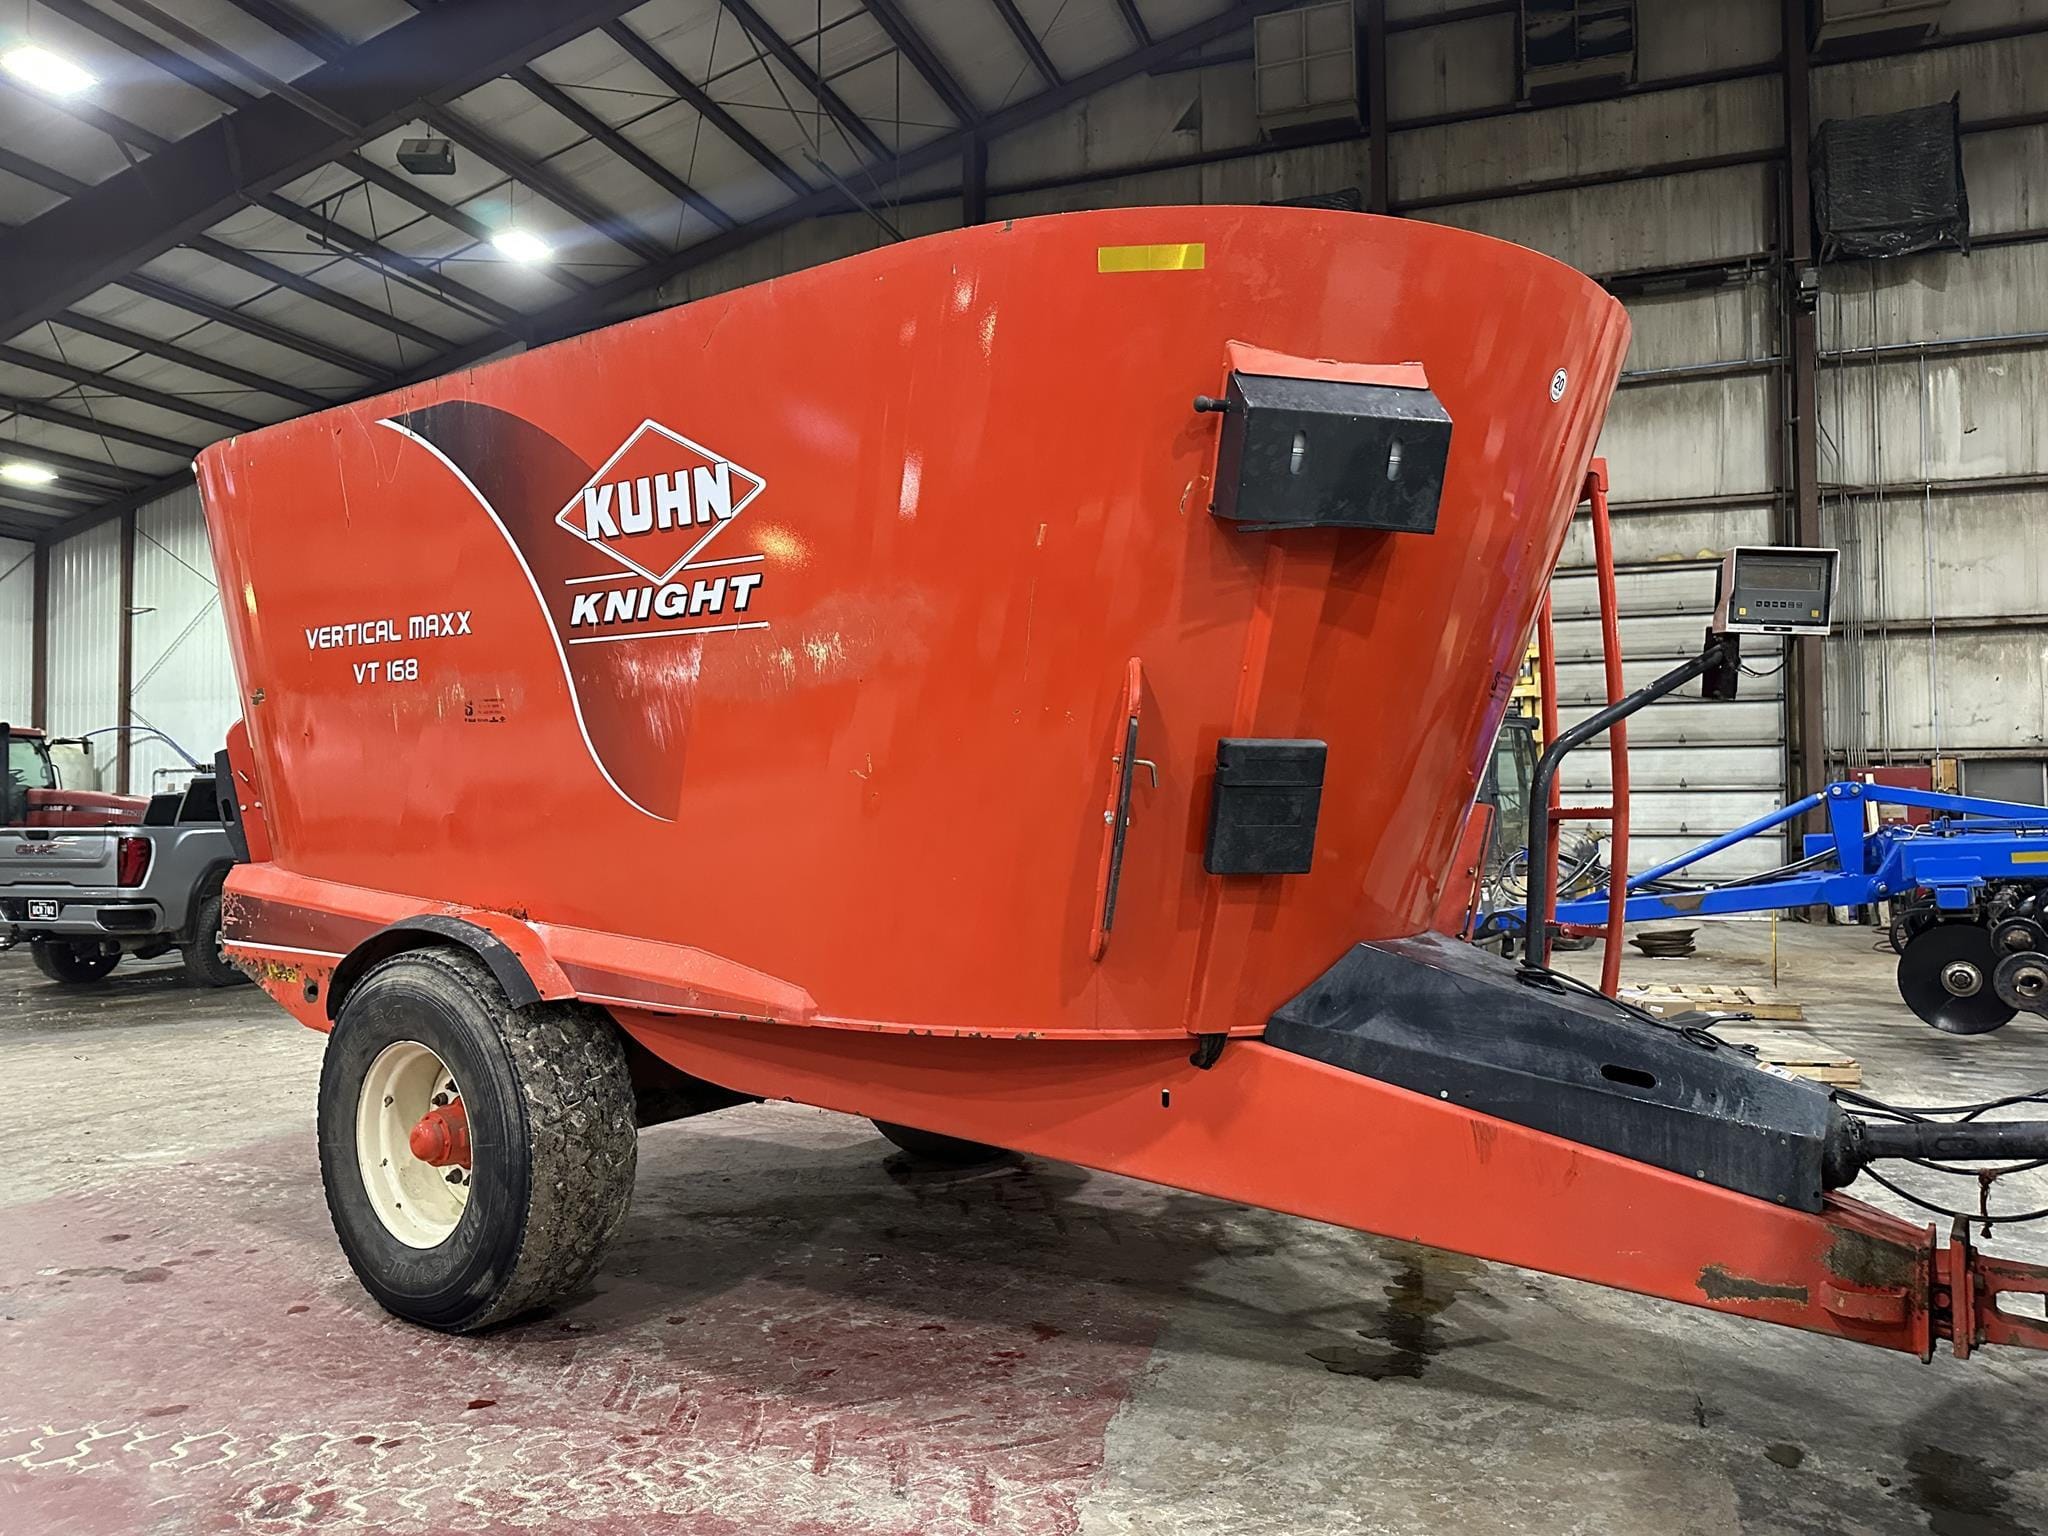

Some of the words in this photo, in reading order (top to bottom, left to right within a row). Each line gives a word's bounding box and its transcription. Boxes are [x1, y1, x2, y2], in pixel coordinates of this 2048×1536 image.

[1554, 375, 1565, 392] 20
[583, 462, 733, 540] KUHN
[570, 573, 763, 627] KNIGHT
[305, 619, 402, 650] VERTICAL
[409, 610, 472, 640] MAXX
[353, 661, 380, 684] VT
[386, 658, 419, 682] 168
